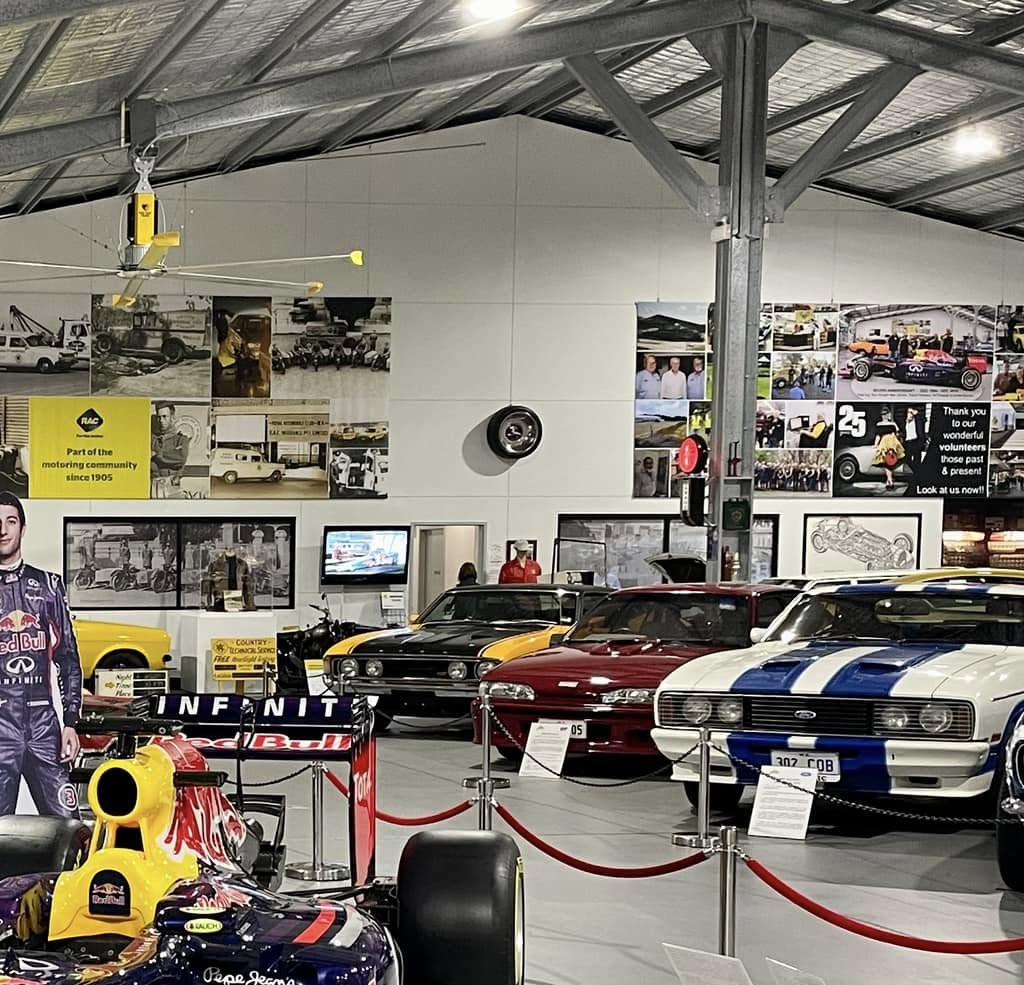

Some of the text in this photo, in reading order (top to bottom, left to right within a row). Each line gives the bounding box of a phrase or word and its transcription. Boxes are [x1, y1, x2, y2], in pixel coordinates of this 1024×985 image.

[943, 406, 987, 417] Thank you
[80, 417, 100, 426] RAC
[838, 405, 866, 438] 25
[951, 419, 960, 428] to
[942, 430, 984, 440] wonderful
[66, 448, 113, 456] Part of the
[939, 443, 987, 452] volunteers
[941, 455, 984, 465] those past
[42, 461, 137, 470] motoring community
[66, 473, 113, 481] since 1905
[941, 467, 982, 478] & present
[916, 485, 984, 495] Look at us now!!
[19, 632, 47, 651] Bull
[229, 647, 257, 655] TECHNICAL
[116, 673, 132, 681] Night
[250, 733, 352, 752] Bull
[203, 966, 244, 985] Pepe
